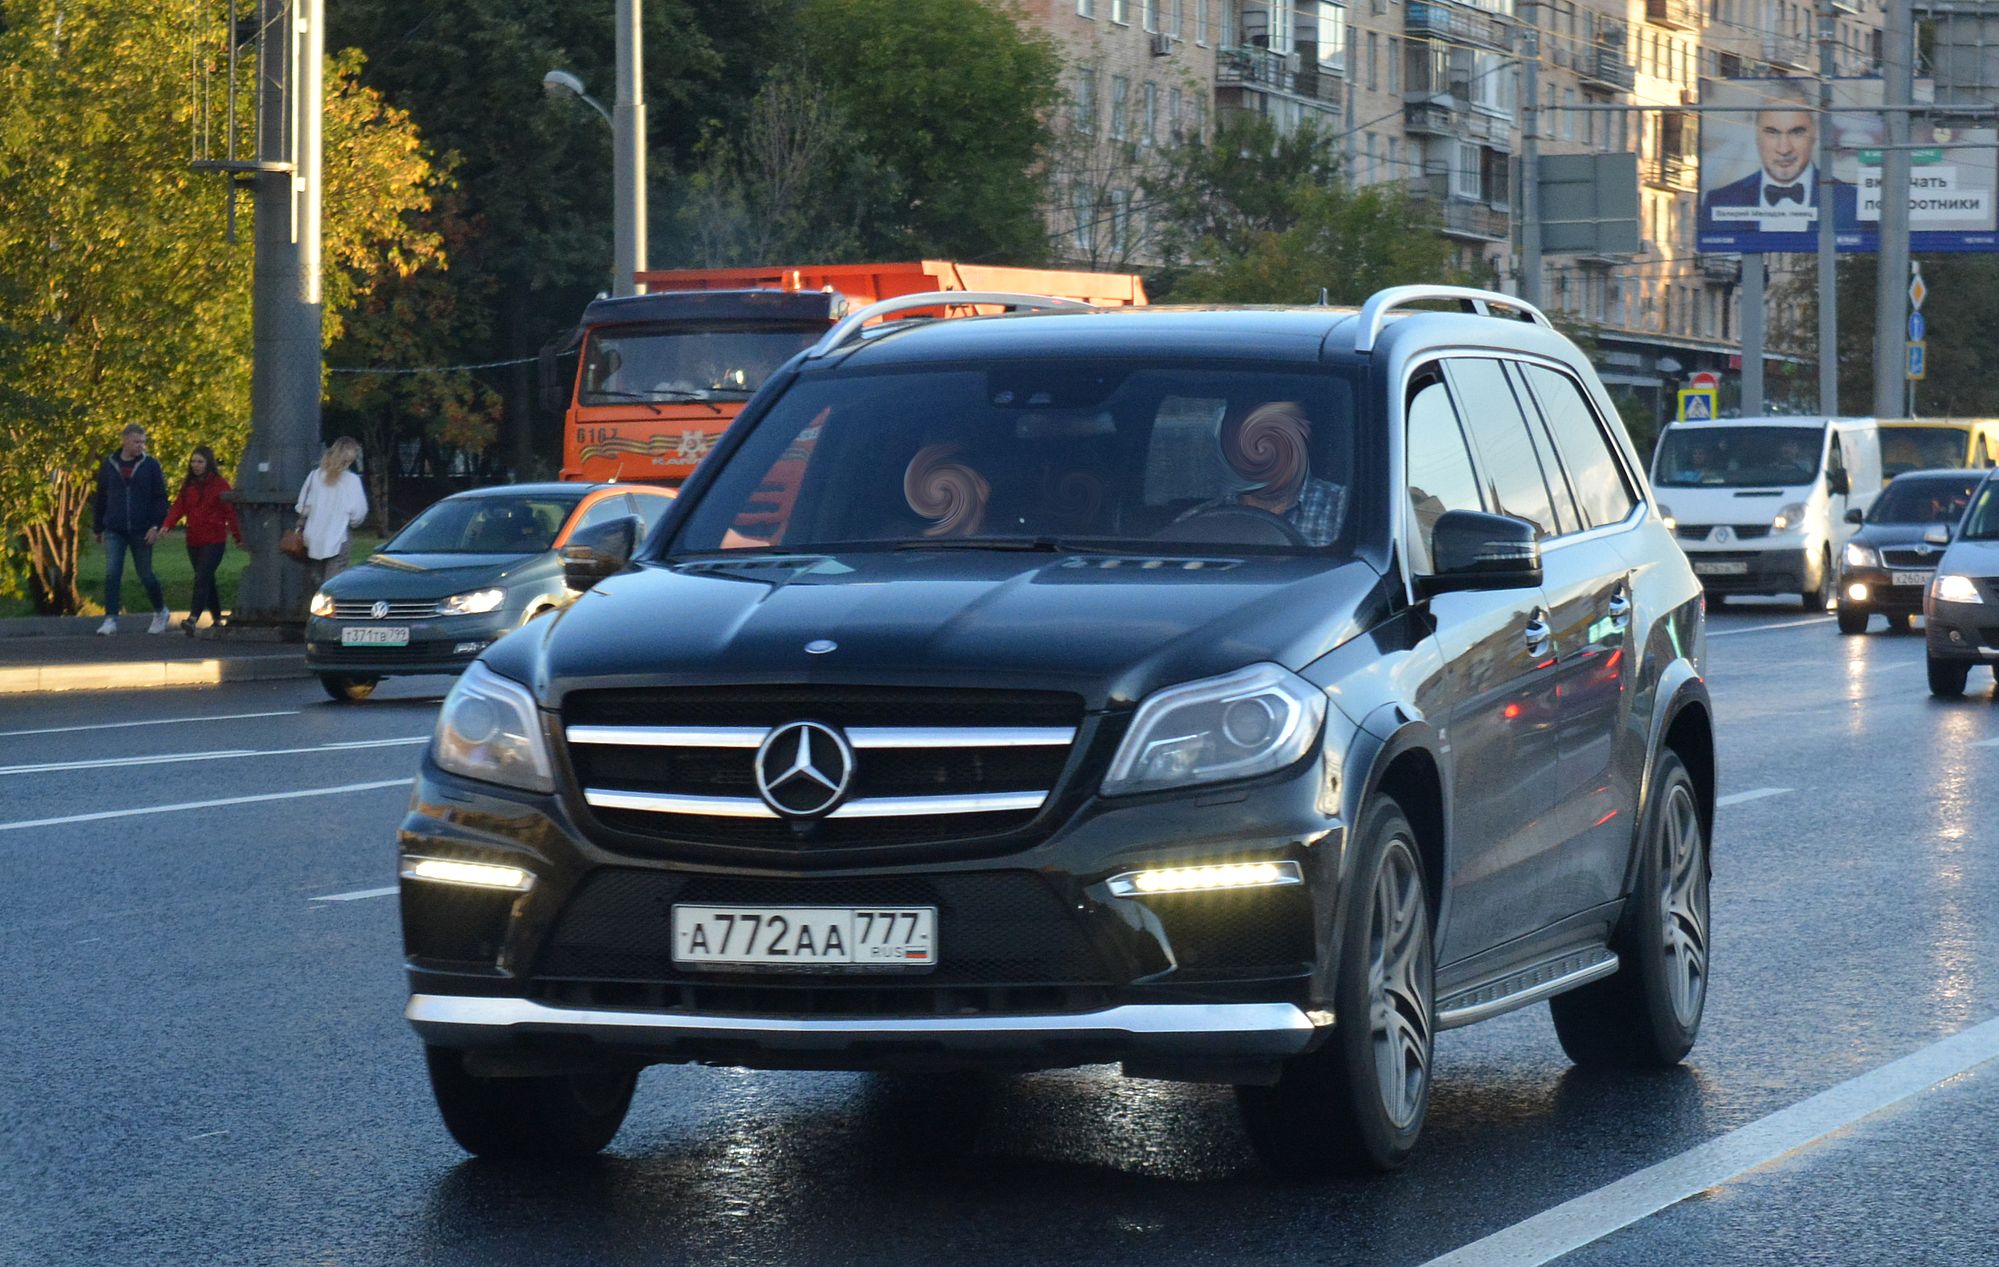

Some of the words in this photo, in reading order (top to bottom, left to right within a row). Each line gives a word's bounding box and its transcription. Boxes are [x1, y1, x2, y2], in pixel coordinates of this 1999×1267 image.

[1864, 177, 1947, 188] вкчать
[1864, 198, 1980, 210] поотники
[689, 914, 846, 957] А772АА
[856, 912, 919, 944] 777
[870, 946, 904, 958] RUS
